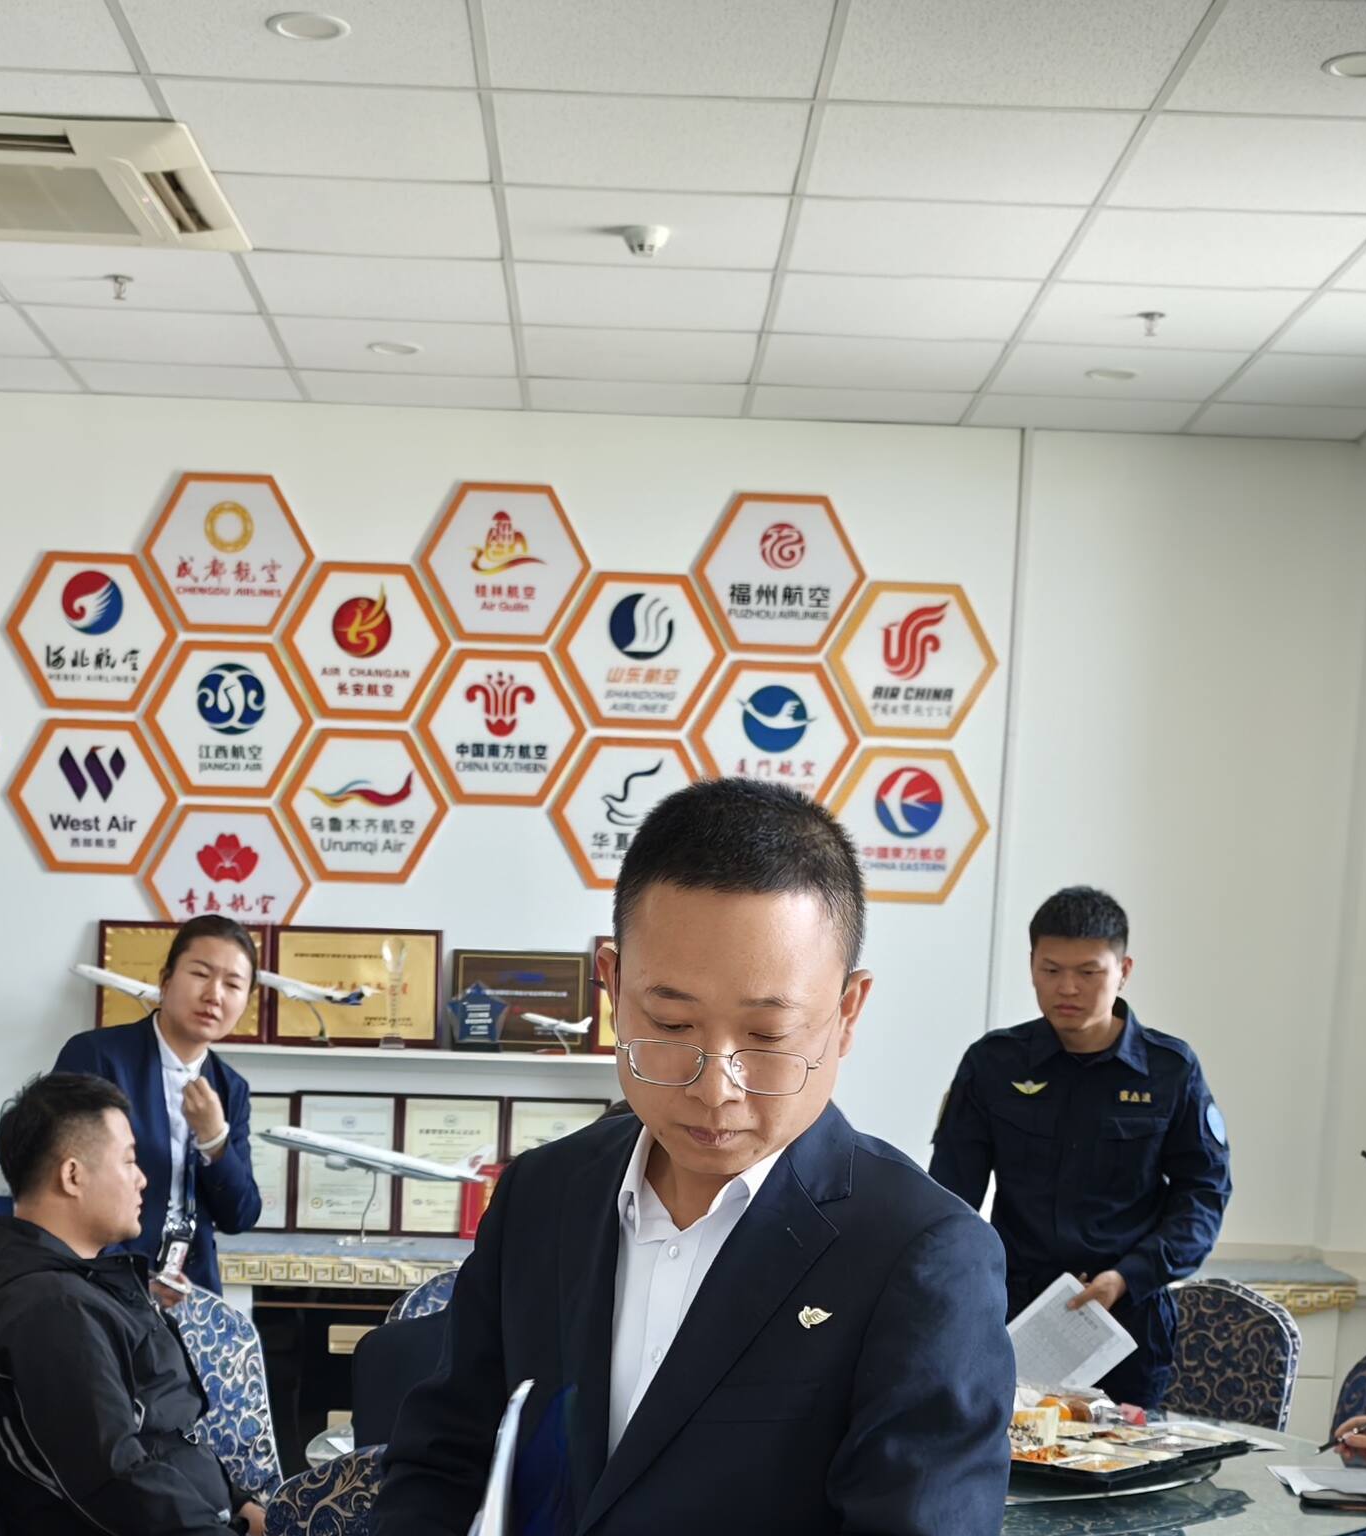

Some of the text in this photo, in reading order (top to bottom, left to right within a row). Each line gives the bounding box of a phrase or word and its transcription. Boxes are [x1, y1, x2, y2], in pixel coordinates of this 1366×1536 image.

[176, 555, 283, 584] 成都航空
[175, 586, 284, 598] CHENGDU AIRLINES
[475, 584, 536, 600] 桂林航空
[728, 583, 831, 608] 福州航空
[480, 602, 496, 612] Air
[727, 608, 830, 621] FUZHOU AIRLINES
[45, 645, 142, 671] 河北航空
[47, 673, 138, 684] HEBEI AIRLINES
[320, 667, 411, 679] AIR CHANGAN
[606, 667, 681, 685] 山东航空
[336, 683, 395, 698] 长安航空
[604, 689, 677, 701] SHANDONG
[872, 686, 954, 701] AIR CHINA
[609, 702, 669, 713] AIRLINES
[198, 744, 264, 760] 江西航空
[455, 743, 548, 760] 中国南方航空
[198, 761, 264, 773] JIANGXI AIR
[455, 761, 547, 774] CHINA SOUTHERN
[49, 813, 138, 833] West Air
[310, 816, 416, 835] 乌鲁木齐航空
[70, 837, 117, 849] 西部航空
[319, 838, 406, 856] Urumqi Air
[899, 863, 947, 873] EASTERN
